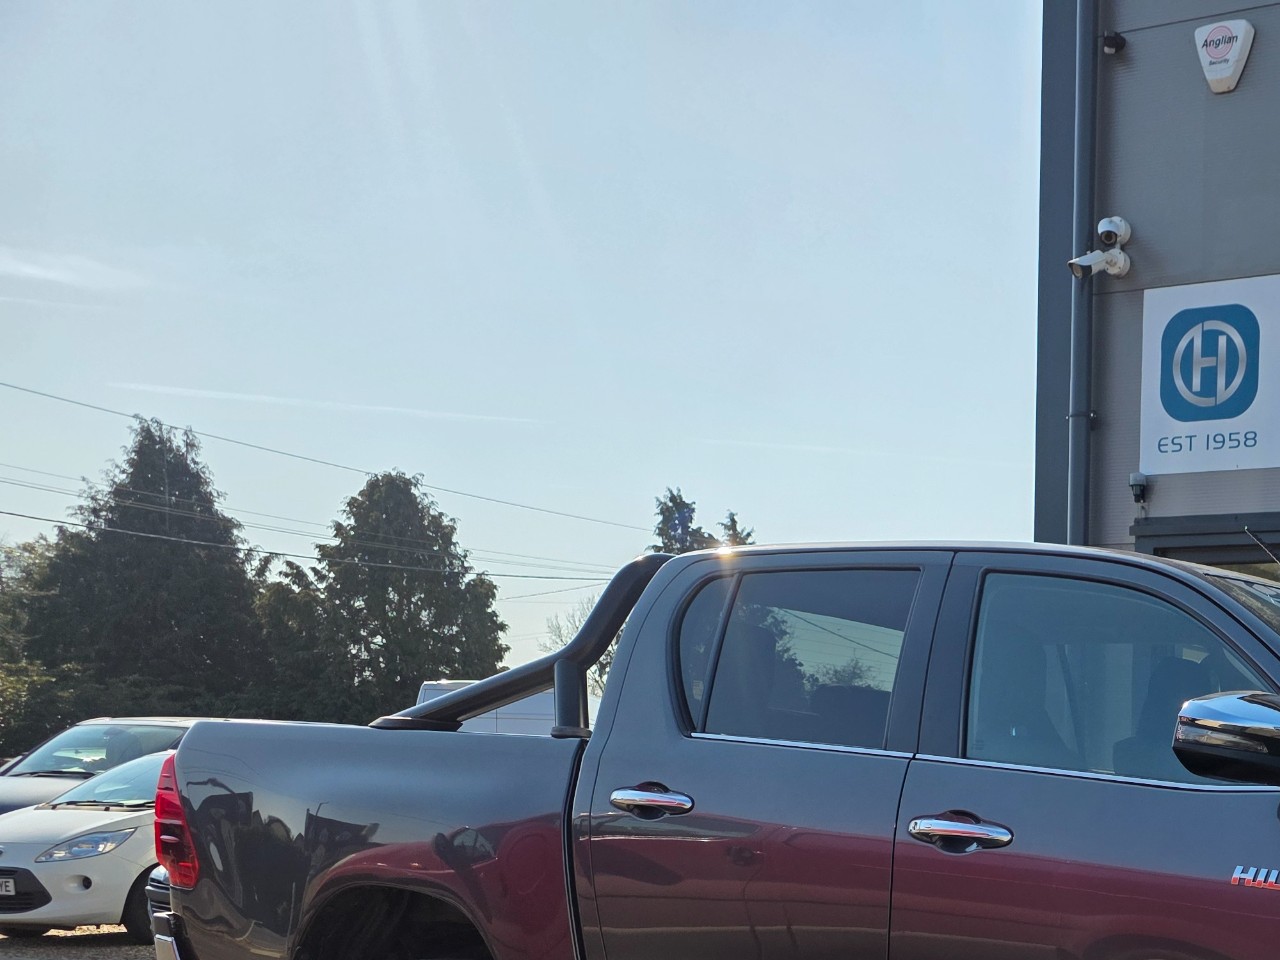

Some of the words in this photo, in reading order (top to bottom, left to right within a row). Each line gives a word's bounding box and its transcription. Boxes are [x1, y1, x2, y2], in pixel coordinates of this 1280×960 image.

[1201, 35, 1239, 49] Anglian
[1157, 435, 1198, 454] EST
[1206, 430, 1258, 451] 1958
